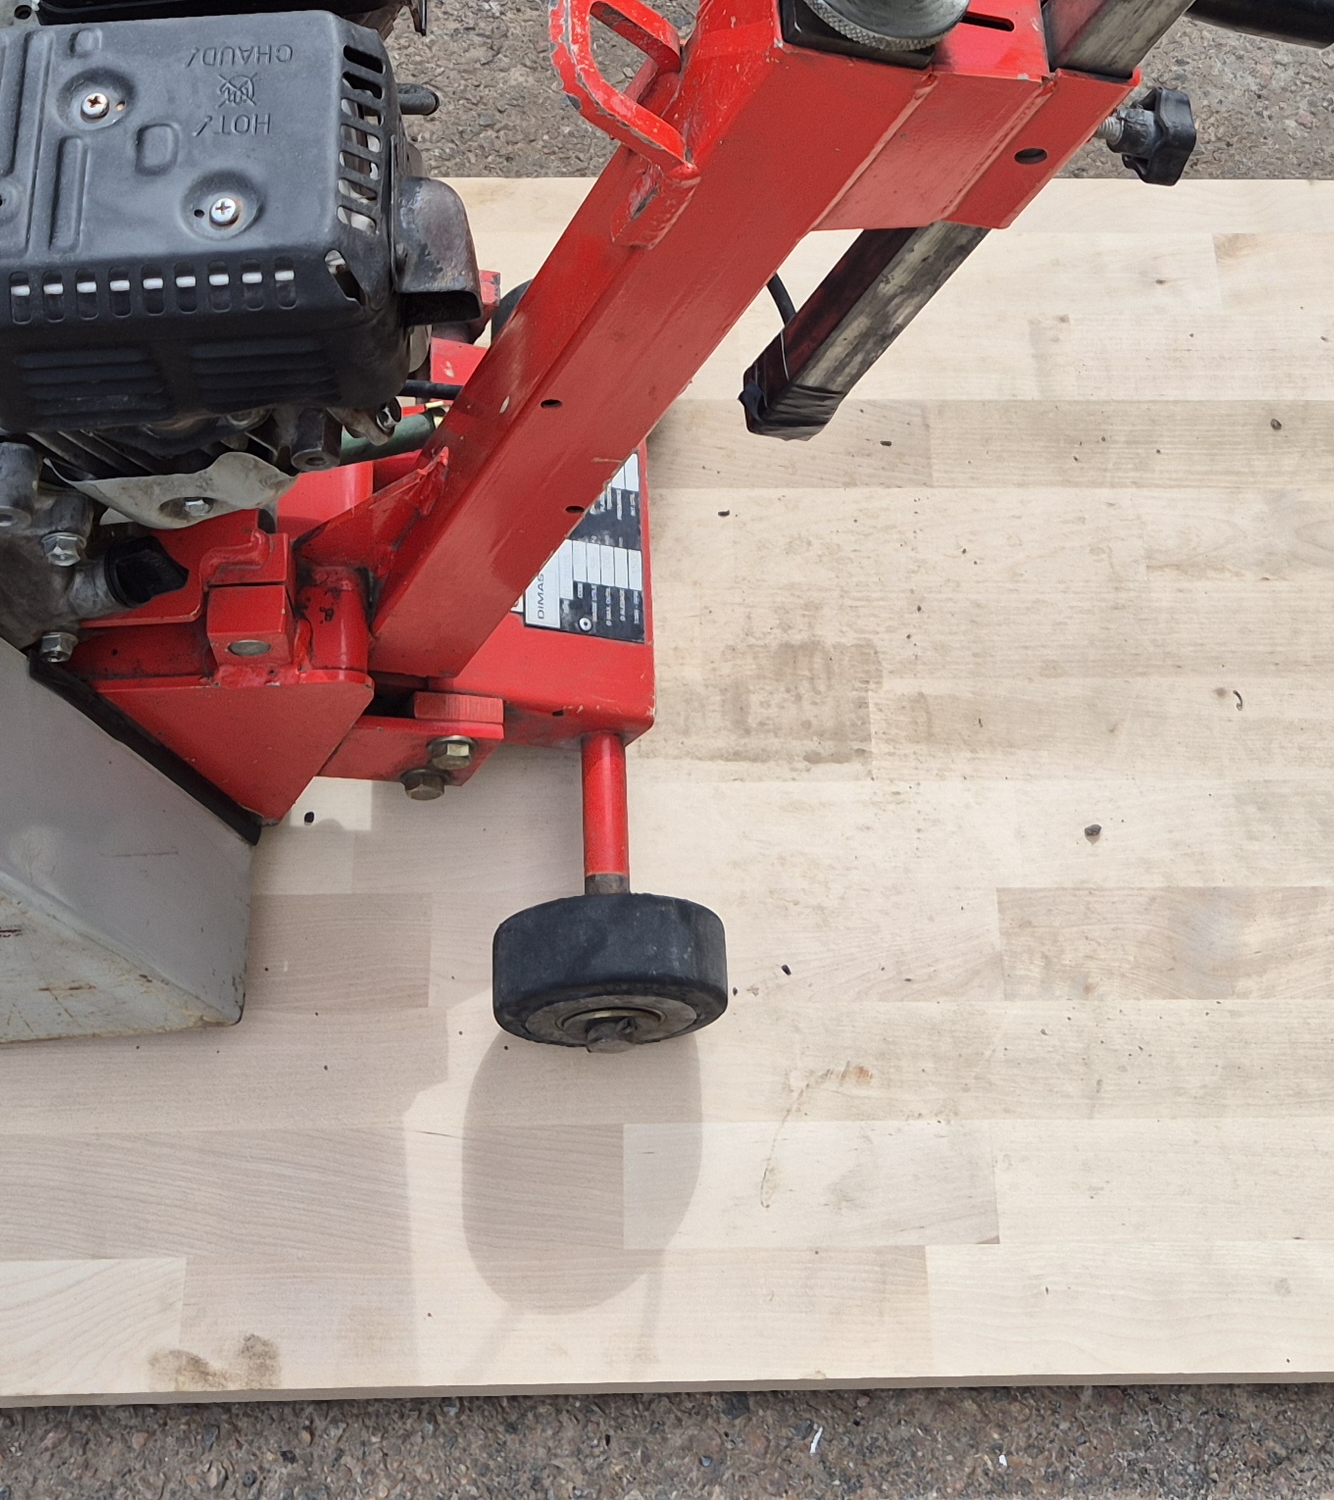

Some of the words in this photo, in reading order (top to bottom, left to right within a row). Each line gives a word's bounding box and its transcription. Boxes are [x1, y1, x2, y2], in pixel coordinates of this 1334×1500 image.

[185, 44, 293, 68] CHAUD!
[192, 113, 271, 137] HOT!
[537, 573, 545, 619] DIMAS
